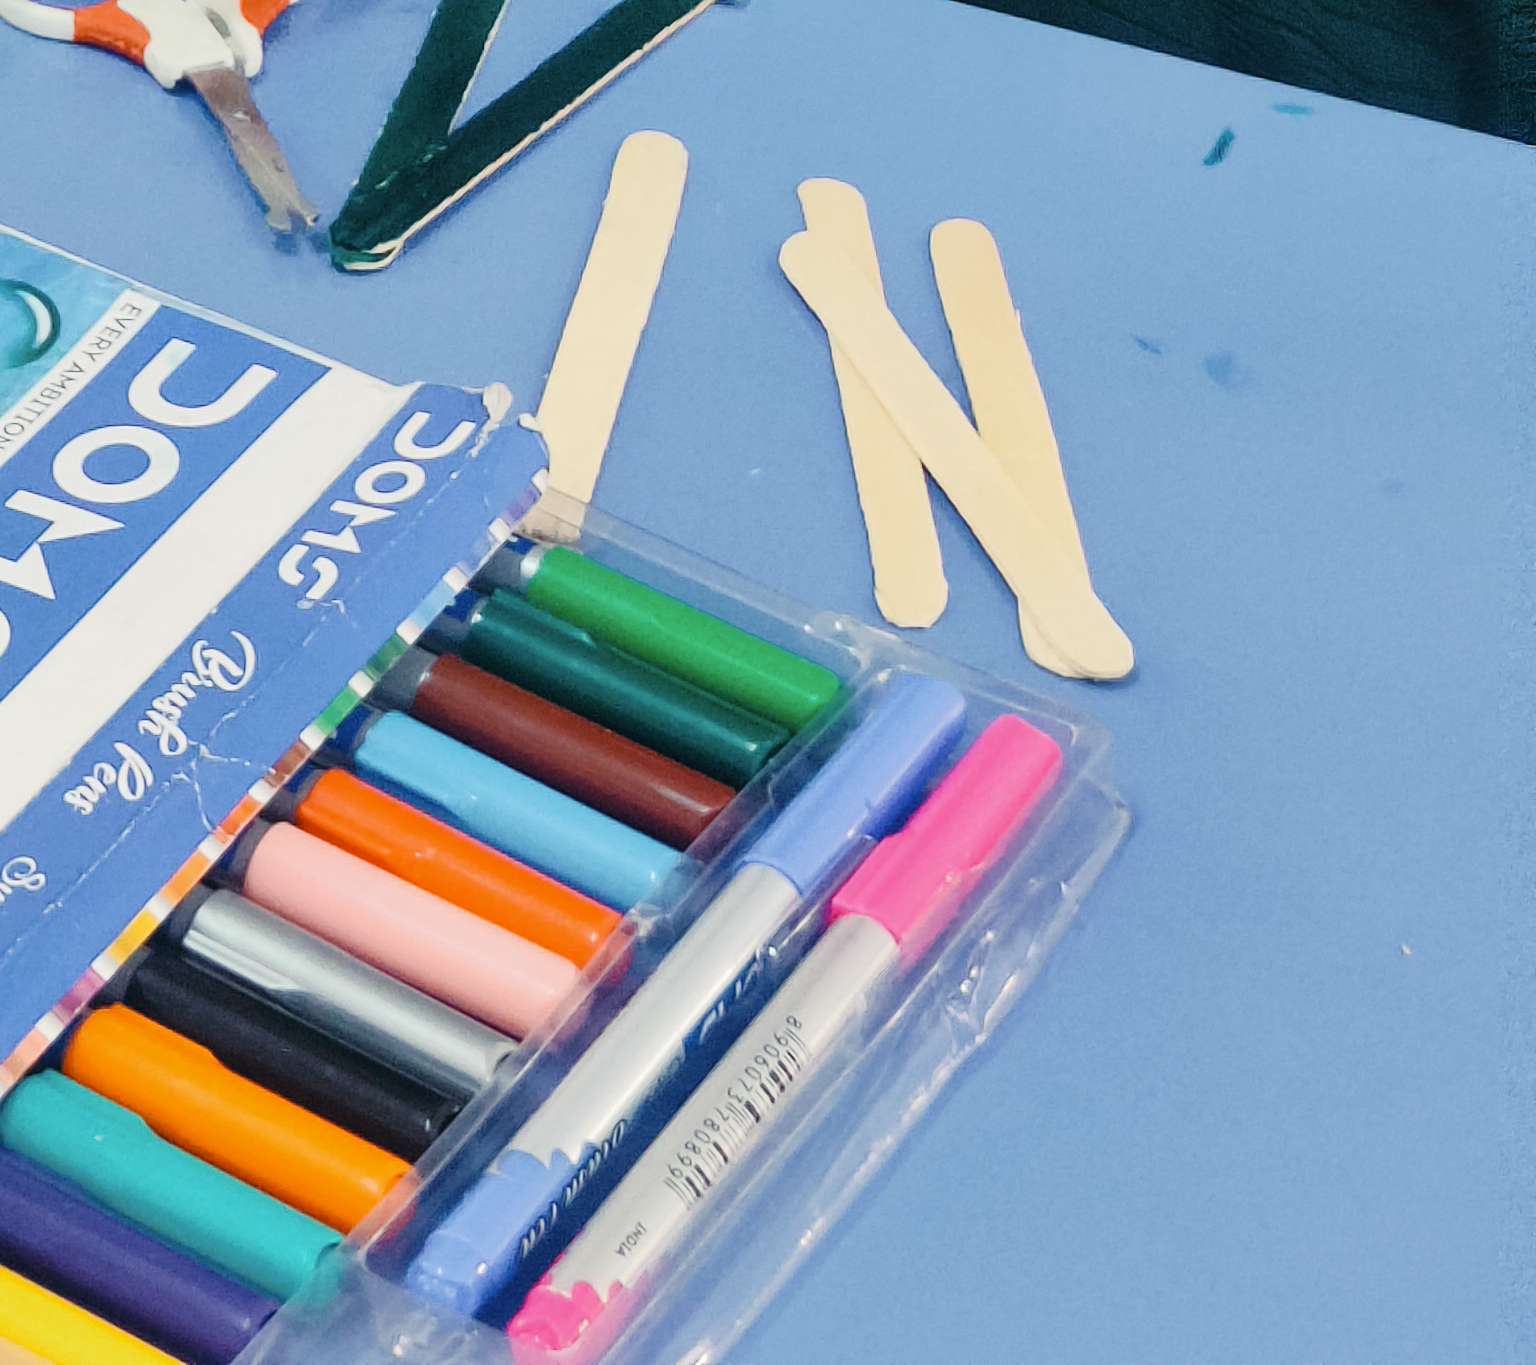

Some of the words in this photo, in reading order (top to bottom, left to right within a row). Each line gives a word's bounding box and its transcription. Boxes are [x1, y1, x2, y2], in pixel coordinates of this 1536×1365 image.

[81, 300, 143, 363] EVERY
[278, 410, 477, 600] DOMS
[137, 629, 257, 756] Brush
[62, 741, 155, 816] Pens
[613, 1221, 648, 1258] INDIA
